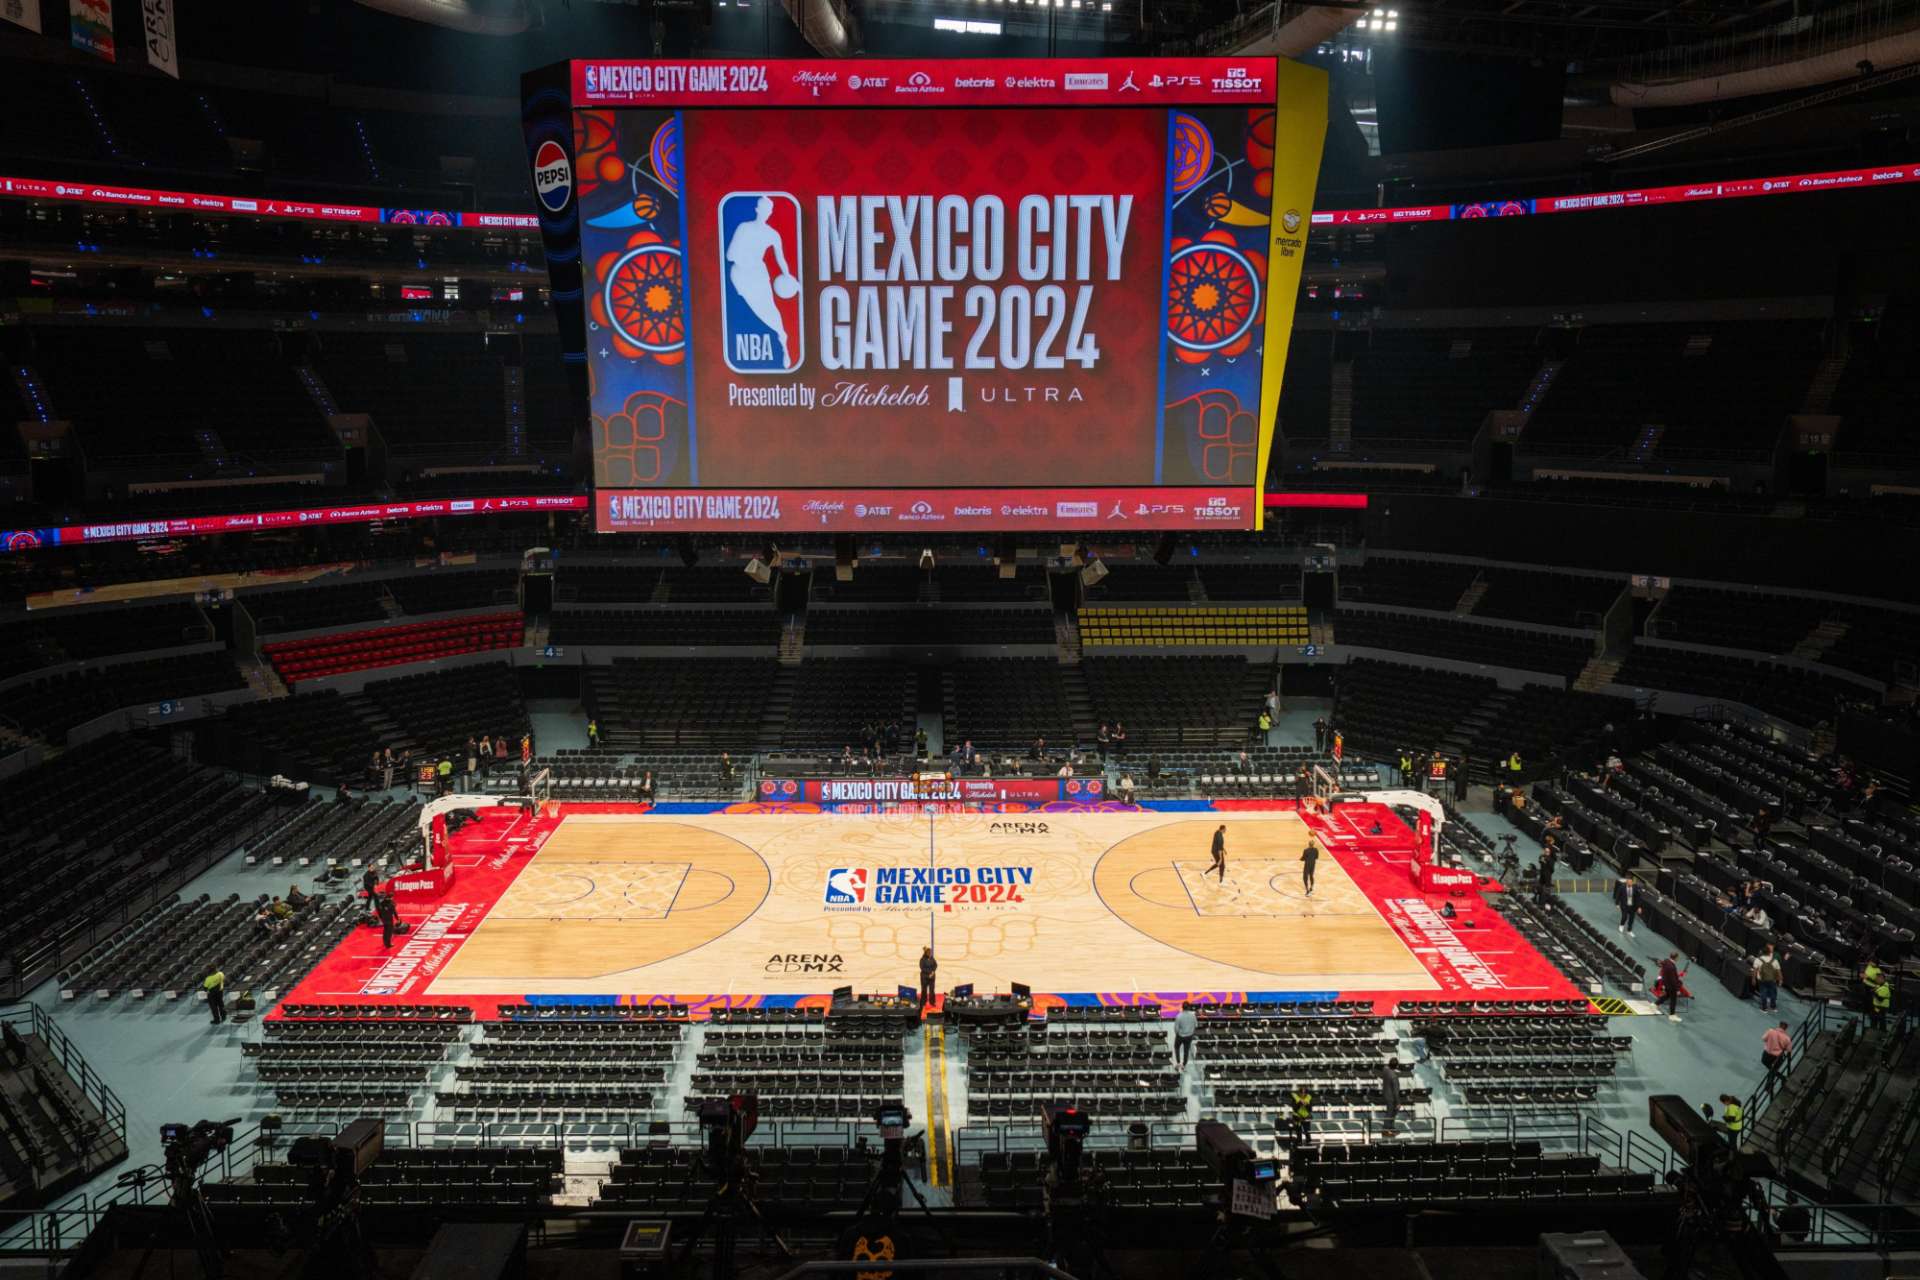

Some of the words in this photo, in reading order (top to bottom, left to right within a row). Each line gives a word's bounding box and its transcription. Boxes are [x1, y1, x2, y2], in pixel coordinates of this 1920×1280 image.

[600, 66, 651, 92] MEXICO
[655, 66, 687, 92] CITY
[689, 66, 727, 92] GAME
[730, 66, 768, 92] 2024
[792, 71, 838, 82] Michelob
[862, 77, 889, 87] AT&T
[1167, 76, 1201, 86] PS5
[954, 77, 995, 88] betcris
[1017, 77, 1055, 88] elektra
[1068, 78, 1105, 87] Emirates
[1211, 78, 1262, 88] TISSOT
[895, 85, 919, 93] Banco
[919, 85, 945, 93] Azteca
[537, 167, 569, 186] PEPSI
[1836, 175, 1863, 183] Azteca
[1872, 171, 1903, 180] betcris
[1725, 185, 1754, 193] ULTRA
[1773, 181, 1790, 189] AT&T
[127, 193, 151, 201] Azteca
[294, 206, 314, 214] PS5
[332, 208, 361, 216] TISSOT
[1405, 209, 1432, 217] TISSOT
[817, 195, 1005, 281] MEXICO
[1018, 194, 1134, 281] CITY
[1276, 237, 1301, 248] mercado
[818, 285, 955, 370] GAME
[964, 285, 1100, 369] 2024
[736, 333, 774, 361] NBA
[728, 382, 798, 407] Presented
[800, 382, 816, 410] by
[981, 387, 1083, 401] ULTRA
[360, 508, 380, 516] Azteca
[622, 495, 671, 519] MEXICO
[674, 495, 703, 519] CITY
[706, 495, 742, 519] GAME
[744, 495, 780, 519] 2024
[868, 506, 893, 516] AT&T
[954, 506, 992, 516] betcris
[1012, 505, 1048, 516] elektra
[1152, 505, 1184, 514] PS5
[1194, 507, 1240, 516] TISSOT
[90, 526, 115, 538] MEXICO
[116, 525, 132, 536] CITY
[132, 523, 150, 535] GAME
[150, 521, 168, 533] 2024
[545, 647, 554, 657] 4
[162, 703, 172, 714] 3
[832, 782, 874, 800] MEXICO
[874, 782, 899, 800] CITY
[876, 867, 971, 885] MEXICO
[977, 867, 1033, 885] CITY
[1457, 873, 1472, 884] Pass
[400, 880, 420, 891] League
[420, 880, 434, 889] Pass
[875, 885, 947, 903] GAME
[951, 885, 1025, 903] 2024
[457, 903, 486, 931] ULTRA
[368, 957, 422, 987] MEXICO
[397, 940, 437, 957] CITY
[430, 902, 470, 921] 2024
[768, 954, 844, 963] ARENA
[765, 963, 843, 973] CDMX
[1427, 956, 1462, 990] ULTRA
